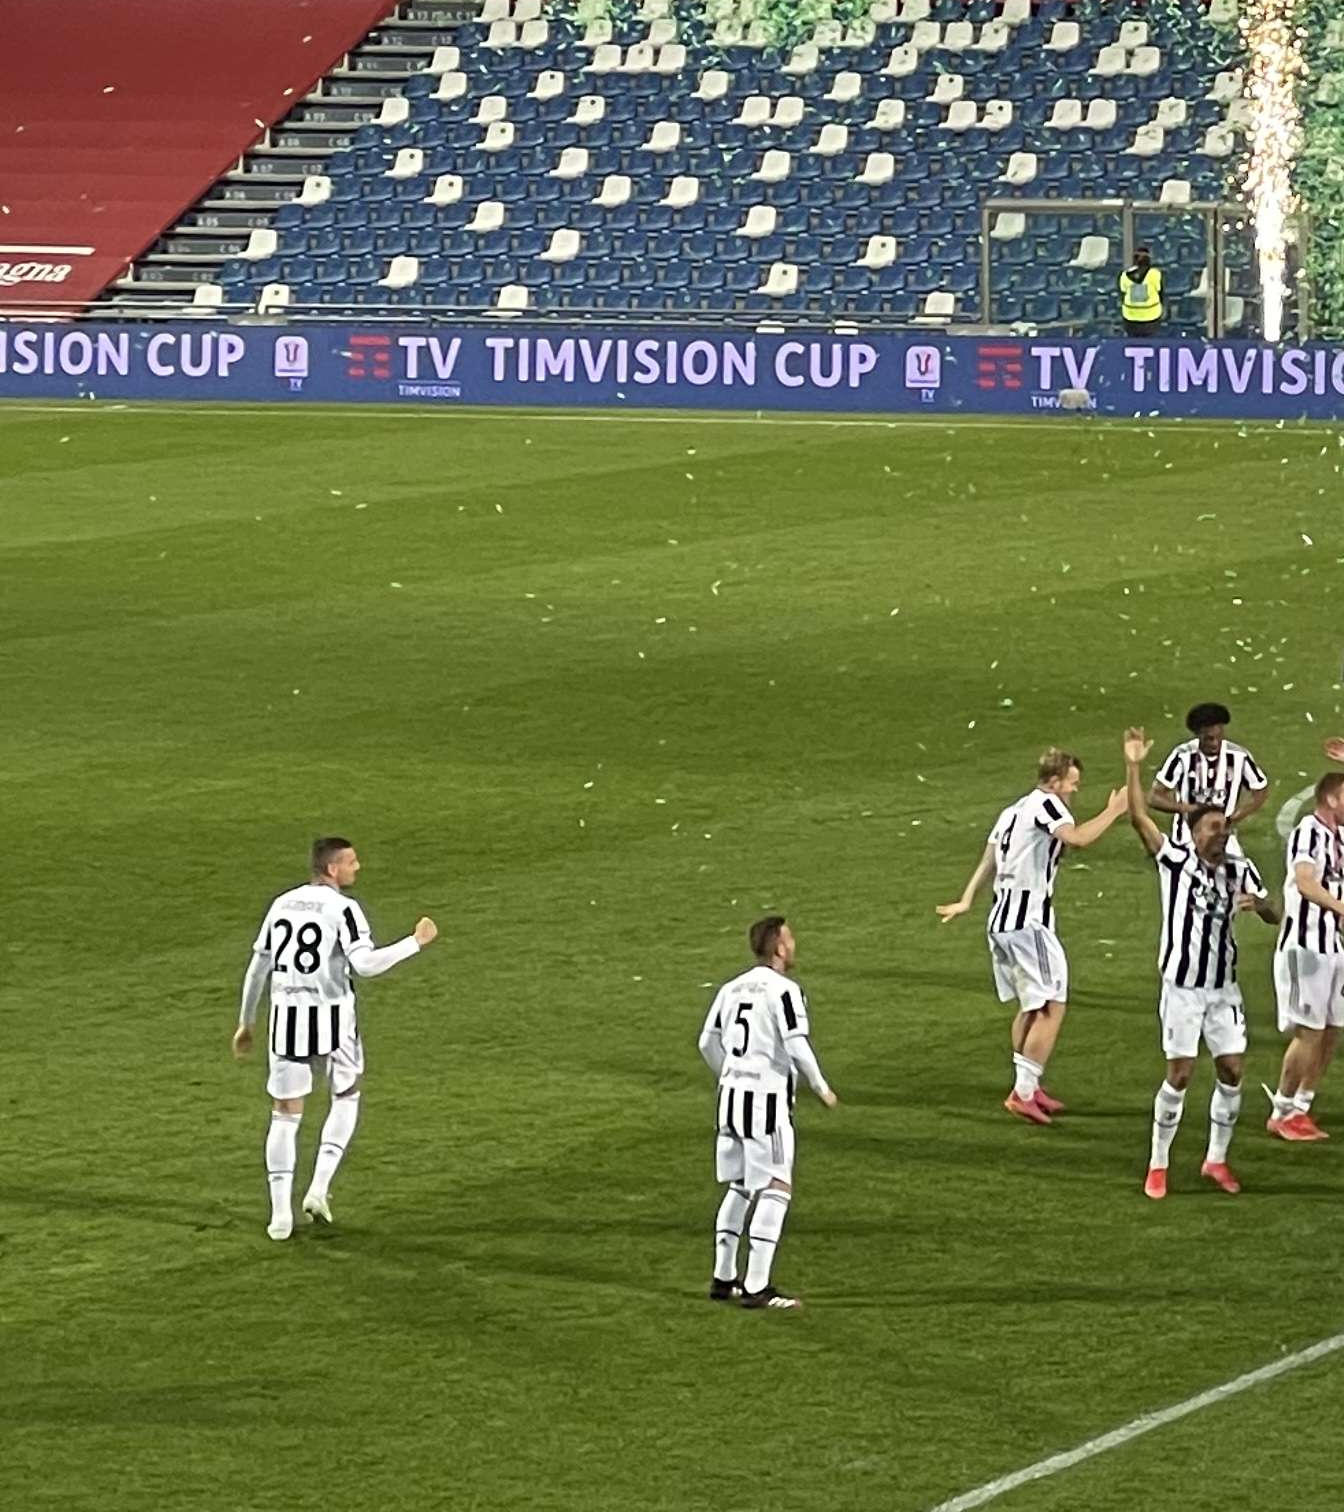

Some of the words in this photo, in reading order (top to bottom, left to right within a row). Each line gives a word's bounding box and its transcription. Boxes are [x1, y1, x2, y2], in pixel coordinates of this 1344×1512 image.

[146, 332, 244, 377] CUP
[398, 337, 462, 380] TV
[485, 337, 756, 386] TIMVISION
[774, 342, 877, 388] CUP
[1030, 346, 1098, 390] TV
[272, 918, 322, 974] 28
[732, 1002, 753, 1057] 5
